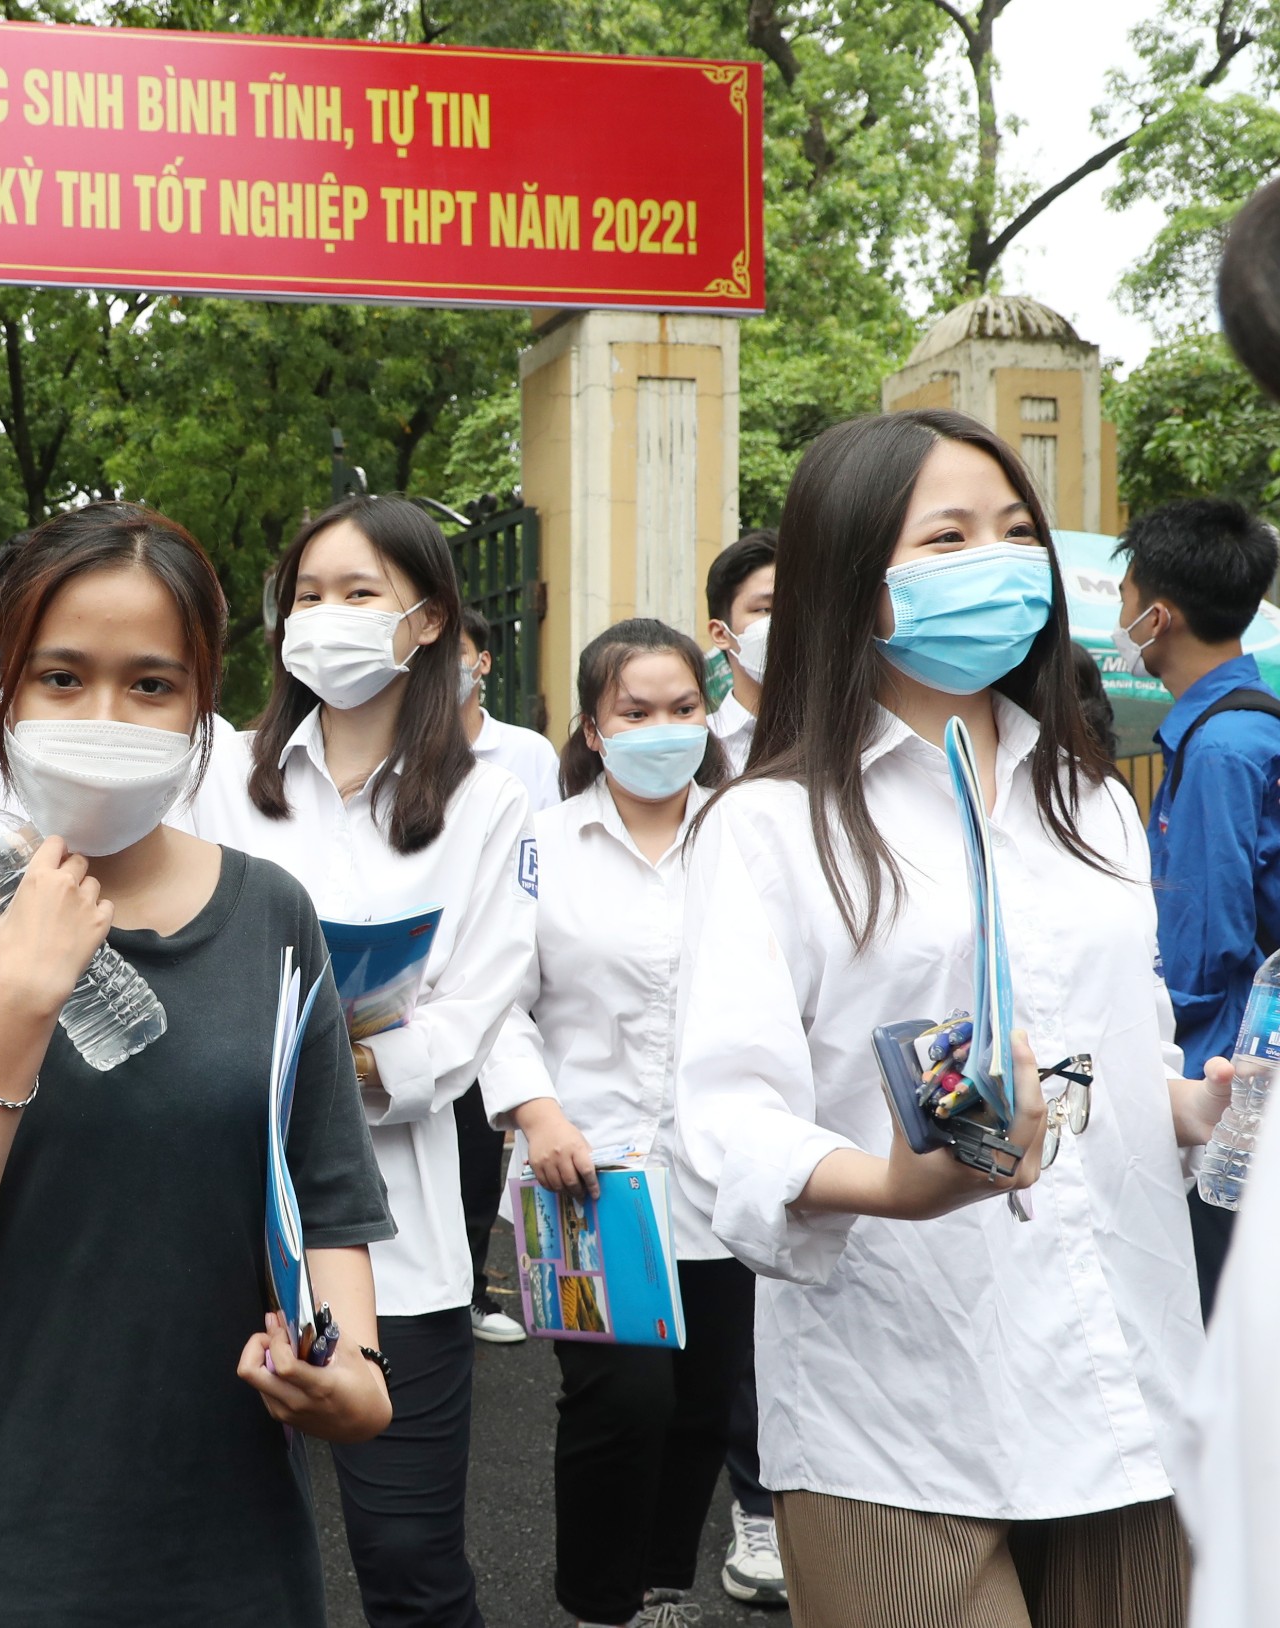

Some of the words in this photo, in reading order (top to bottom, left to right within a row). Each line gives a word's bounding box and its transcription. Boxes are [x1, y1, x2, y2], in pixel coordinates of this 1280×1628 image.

[23, 68, 124, 129] SINH
[138, 65, 237, 136] BÌNH
[249, 72, 354, 149] TĨNH,
[366, 85, 419, 158] TỰ
[426, 92, 490, 149] TIN
[55, 170, 121, 230] THI
[133, 156, 208, 234] TỐT
[220, 172, 369, 253] NGHIỆP
[380, 187, 477, 246] THPT
[490, 182, 579, 251] NĂM
[593, 198, 697, 255] 2022!
